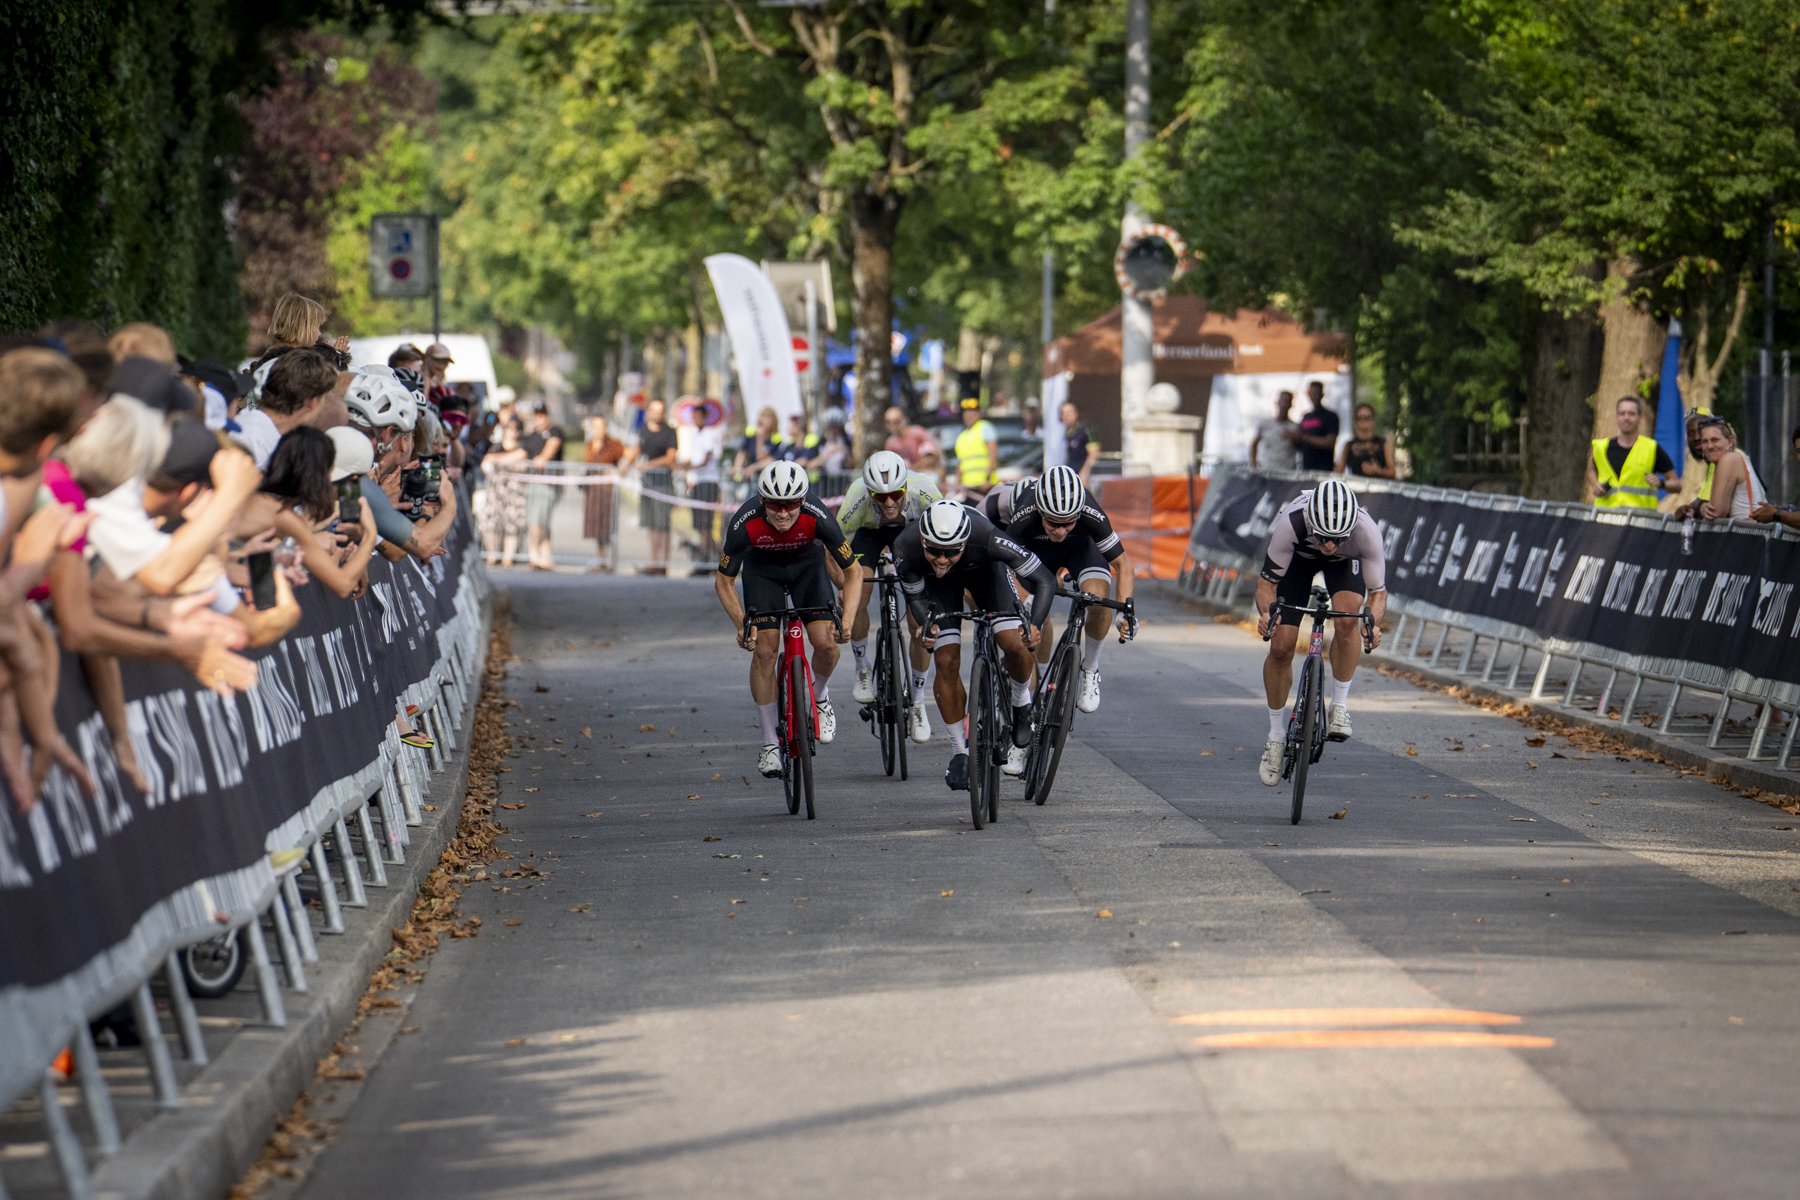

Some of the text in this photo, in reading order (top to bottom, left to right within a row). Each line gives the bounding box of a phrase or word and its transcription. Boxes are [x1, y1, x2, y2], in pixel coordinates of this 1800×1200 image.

[739, 508, 757, 523] GIRO
[1082, 505, 1106, 522] REK
[994, 536, 1030, 557] TREK
